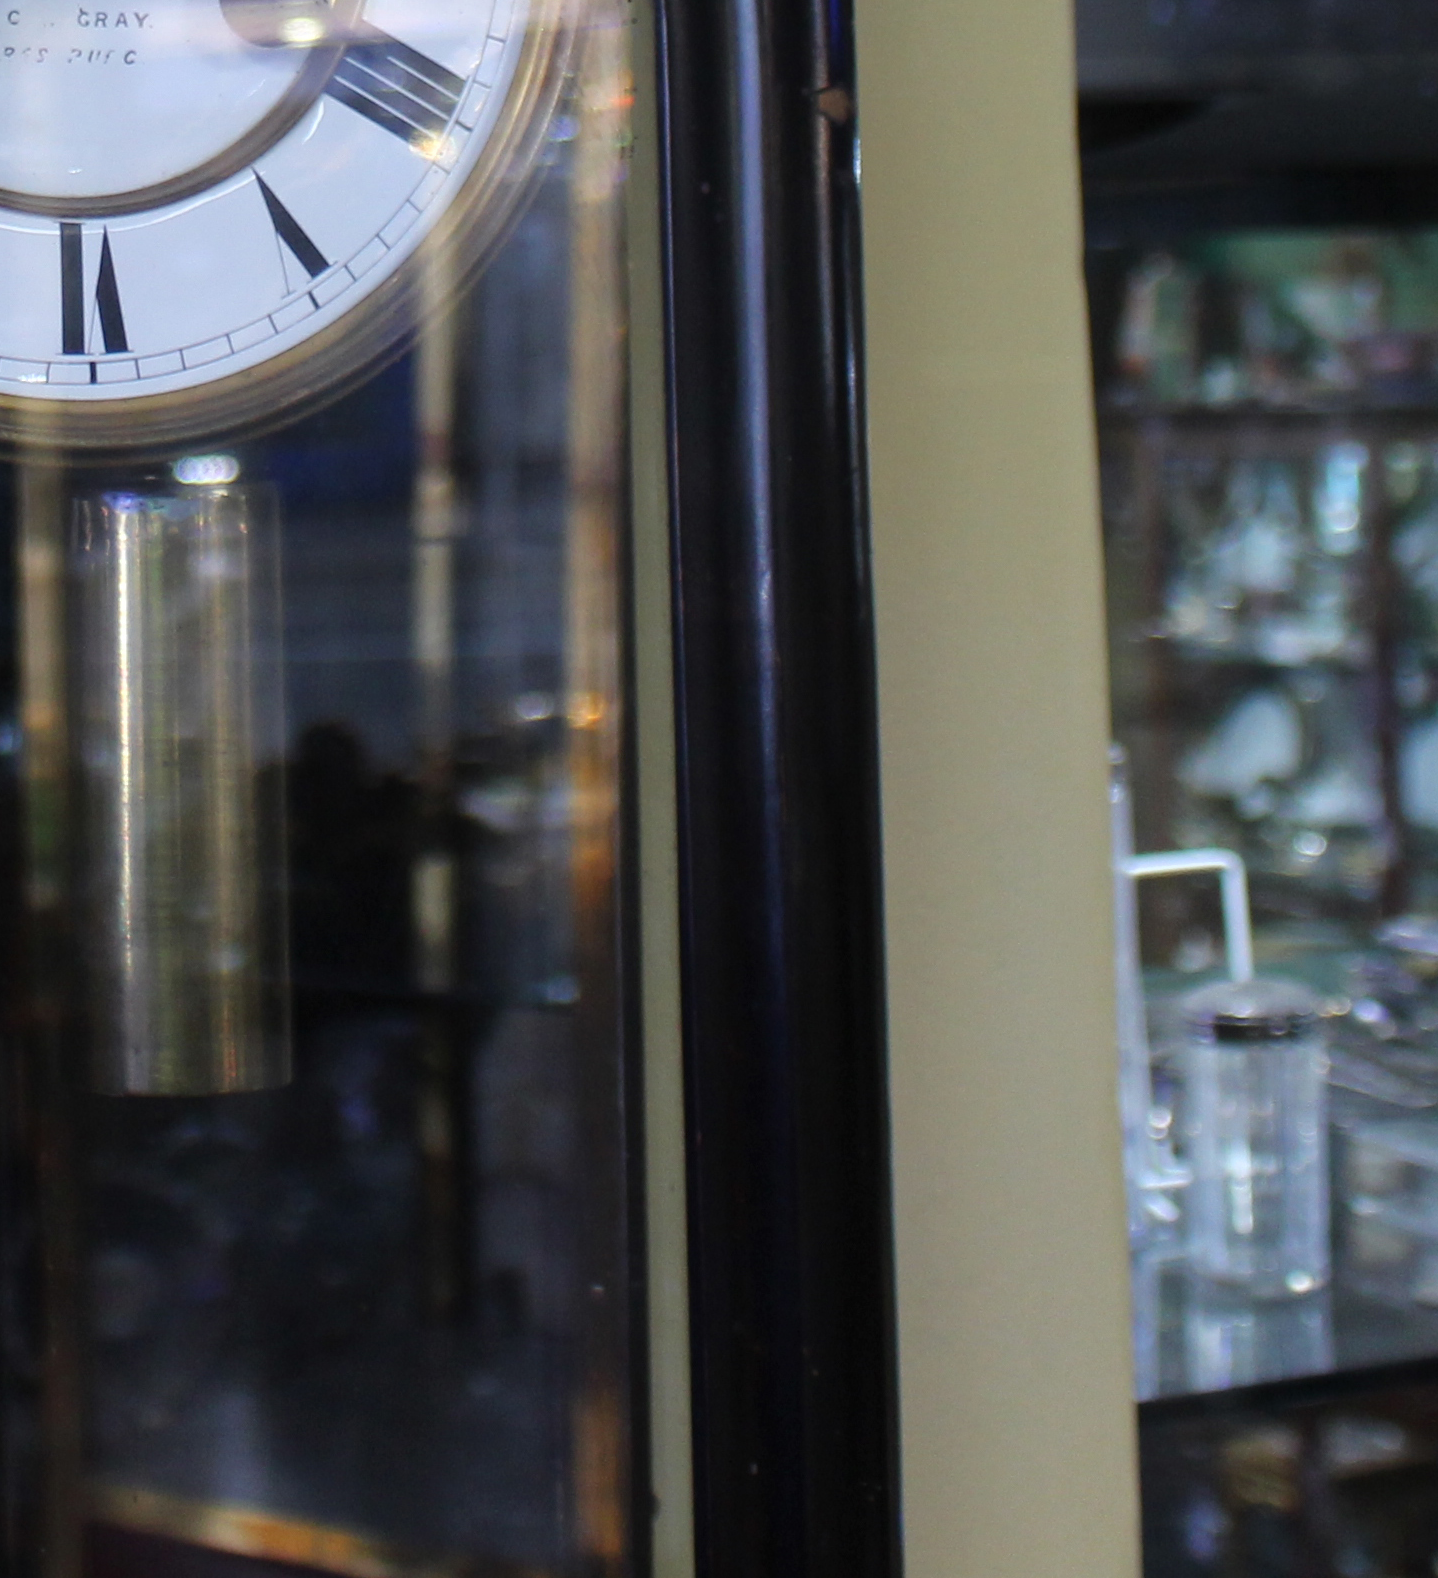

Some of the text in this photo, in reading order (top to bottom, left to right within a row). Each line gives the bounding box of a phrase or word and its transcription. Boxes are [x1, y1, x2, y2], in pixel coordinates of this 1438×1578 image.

[322, 19, 472, 159] IIII
[57, 222, 135, 356] VI
[252, 167, 337, 299] V
